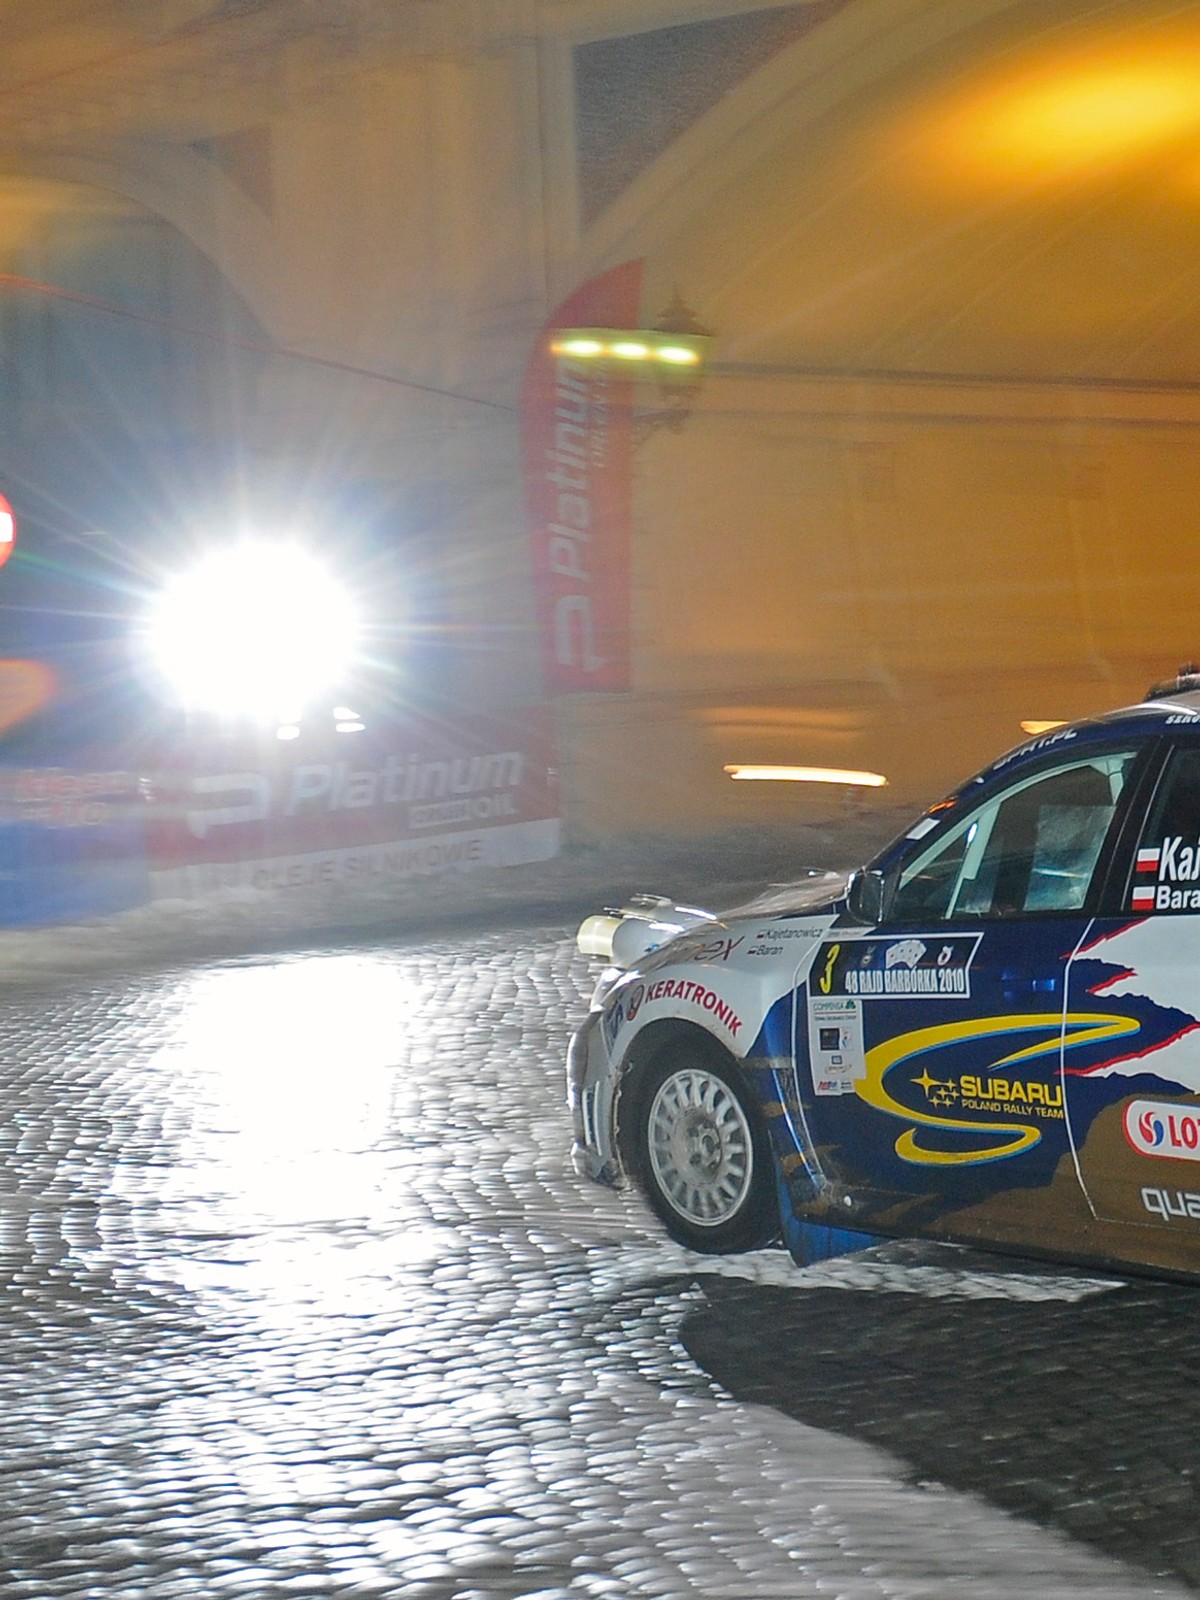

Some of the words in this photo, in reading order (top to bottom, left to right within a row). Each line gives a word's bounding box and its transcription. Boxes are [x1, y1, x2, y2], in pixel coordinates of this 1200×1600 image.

[285, 752, 524, 816] Platinum
[756, 944, 783, 957] Baran
[818, 943, 842, 995] 3
[845, 970, 858, 994] 48
[939, 967, 964, 992] 2010
[645, 979, 743, 1037] KERATRONIK
[959, 1075, 1063, 1107] SUBARU
[962, 1099, 1000, 1113] POLAND
[1003, 1103, 1034, 1117] RALLY
[1035, 1107, 1064, 1119] TEAM
